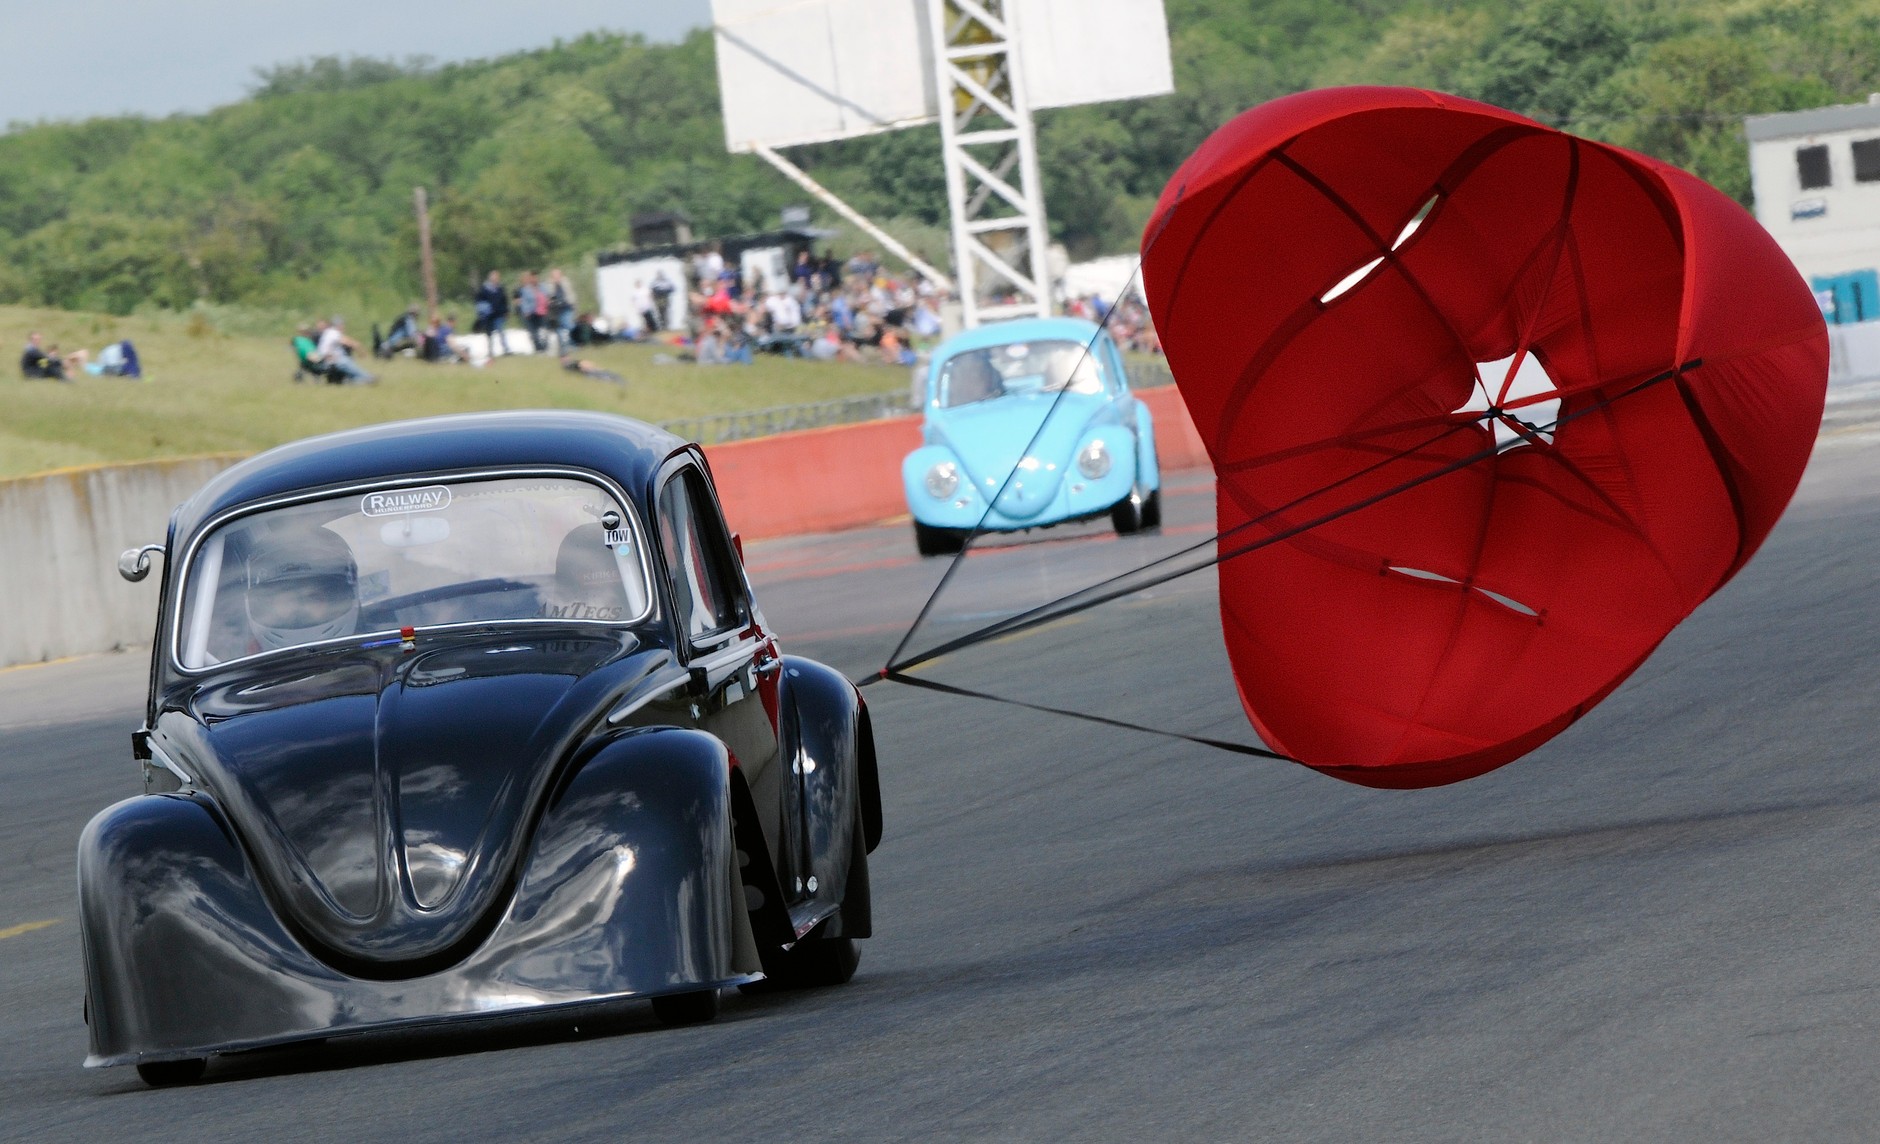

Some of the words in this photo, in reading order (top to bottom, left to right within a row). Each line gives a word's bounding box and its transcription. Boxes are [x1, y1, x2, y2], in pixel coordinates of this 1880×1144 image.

[371, 491, 442, 509] RAILWAY
[374, 503, 433, 514] HUNGERFORD
[606, 530, 629, 543] TOW
